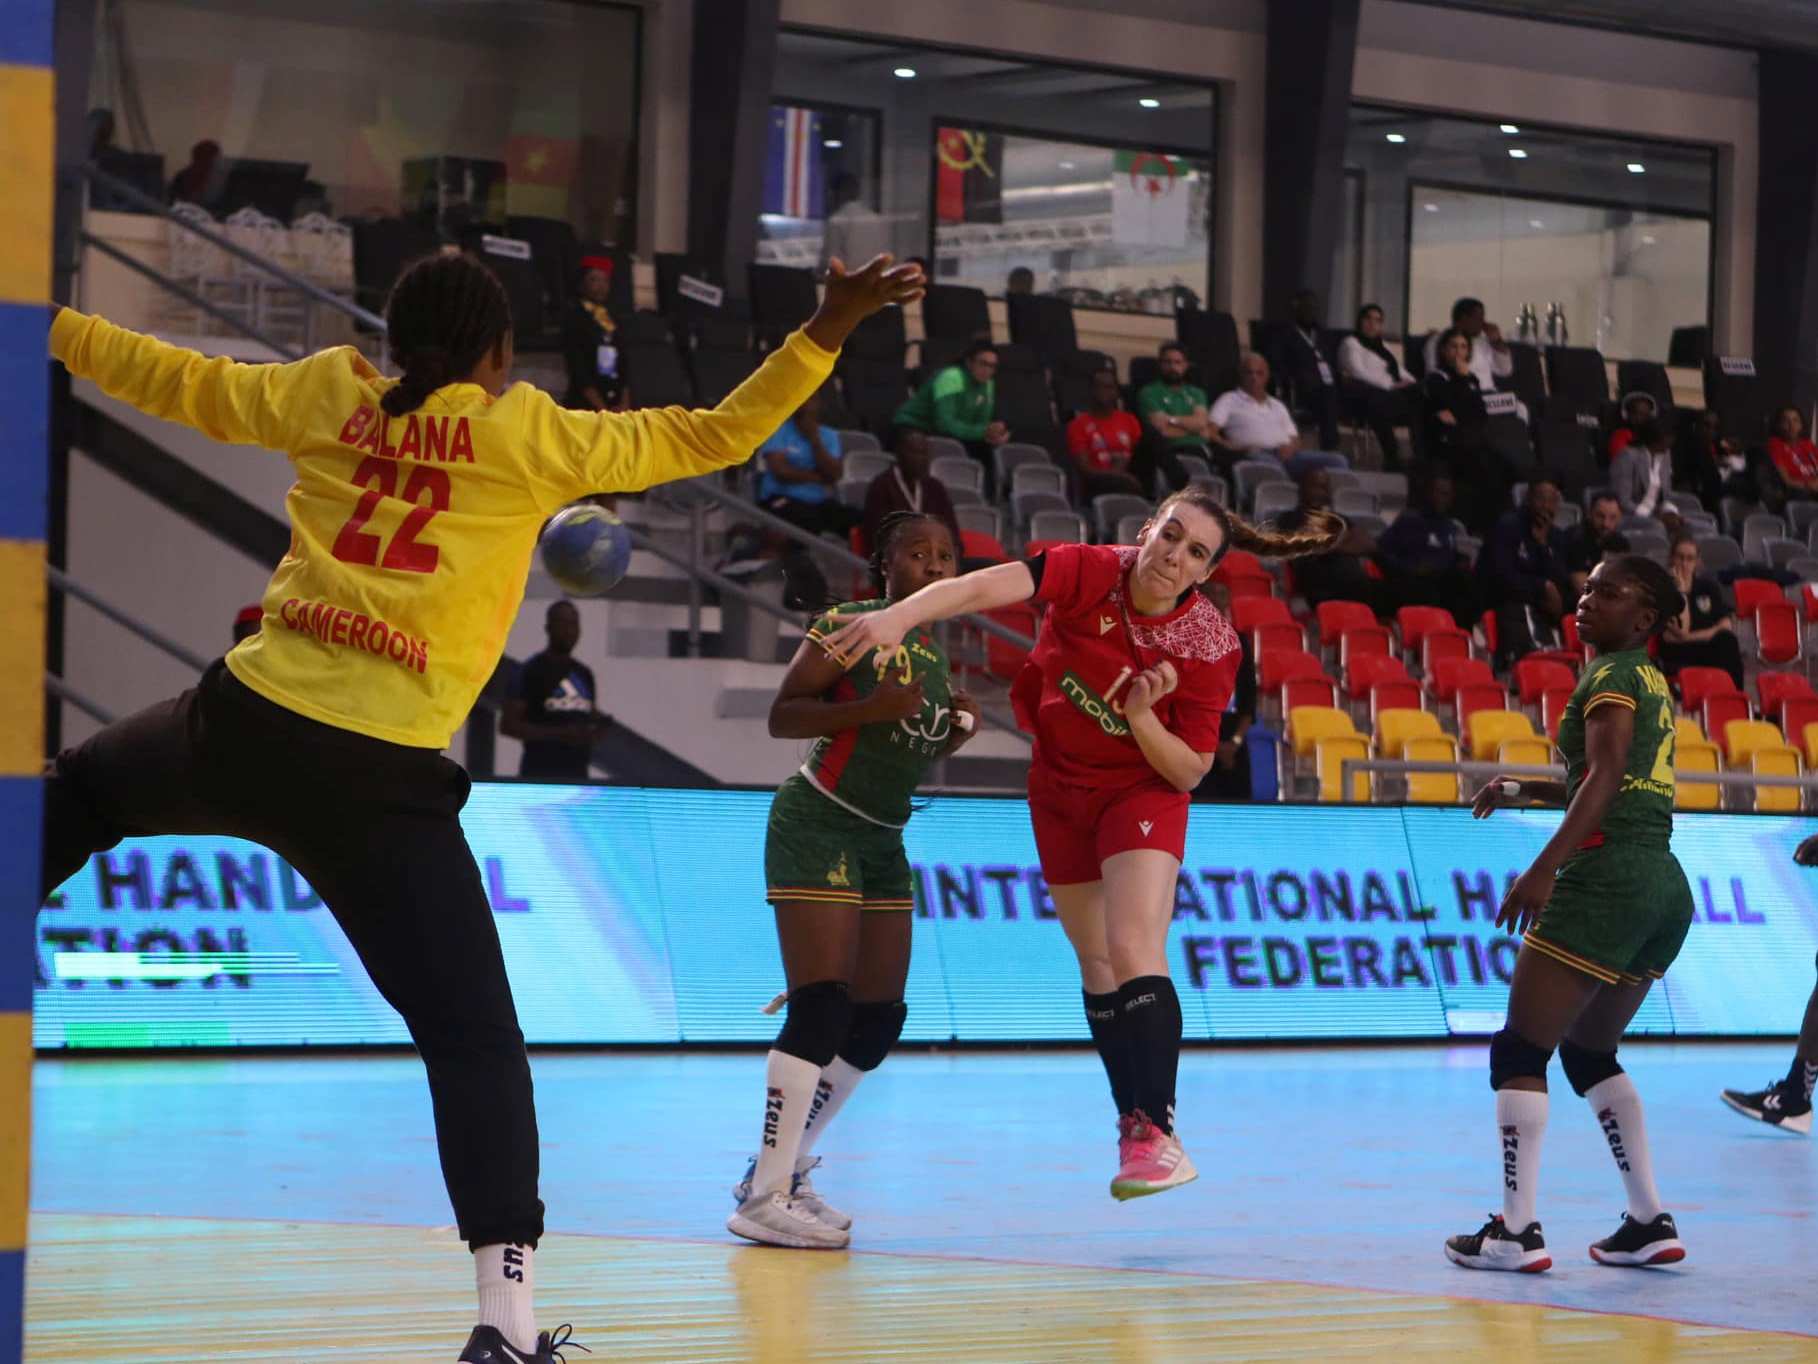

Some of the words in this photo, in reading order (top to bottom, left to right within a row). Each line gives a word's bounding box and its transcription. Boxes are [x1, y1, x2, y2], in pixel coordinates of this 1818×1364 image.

[338, 405, 475, 464] BALANA
[332, 455, 450, 573] 22
[281, 598, 428, 674] CAMEROON
[911, 863, 1437, 922] INTEATIONAL
[1182, 935, 1519, 990] FEDERATIO
[1503, 1137, 1518, 1192] Zeus
[1602, 1119, 1631, 1172] Zeus
